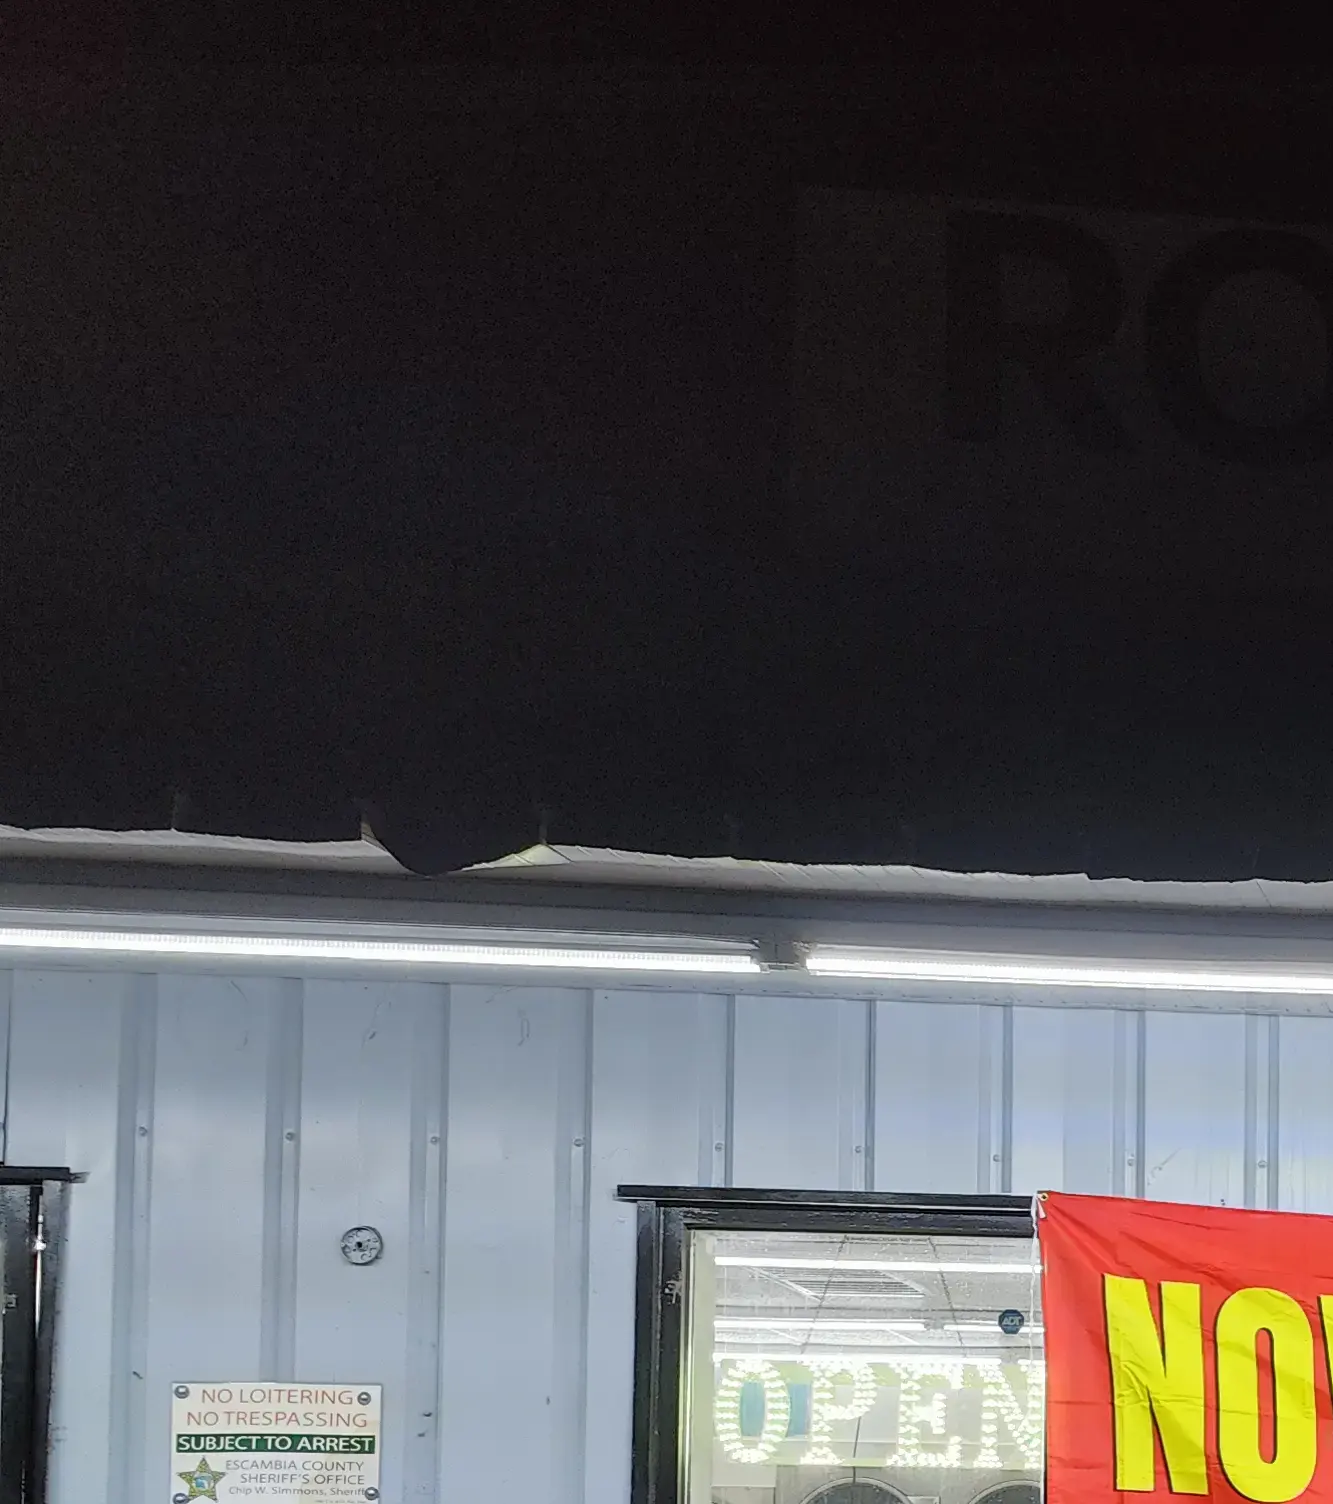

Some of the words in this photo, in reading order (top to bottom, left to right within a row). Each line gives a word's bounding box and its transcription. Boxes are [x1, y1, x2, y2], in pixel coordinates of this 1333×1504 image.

[1002, 1315, 1021, 1326] ADT
[201, 1389, 232, 1403] NO
[239, 1389, 353, 1405] LOITERING
[187, 1412, 219, 1426] NO
[224, 1411, 367, 1428] TRESPASSING
[714, 1359, 1045, 1467] OPEN
[178, 1436, 260, 1451] SUBJECT
[263, 1436, 291, 1450] TO
[296, 1437, 373, 1452] ARREST
[225, 1460, 297, 1471] ESCAMBIA
[302, 1461, 364, 1471] COUNTY
[240, 1474, 310, 1485] SHERIFF'S
[314, 1475, 365, 1485] OFFICE
[229, 1486, 252, 1496] Chip
[255, 1486, 269, 1495] W.
[271, 1487, 327, 1497] Simmons,
